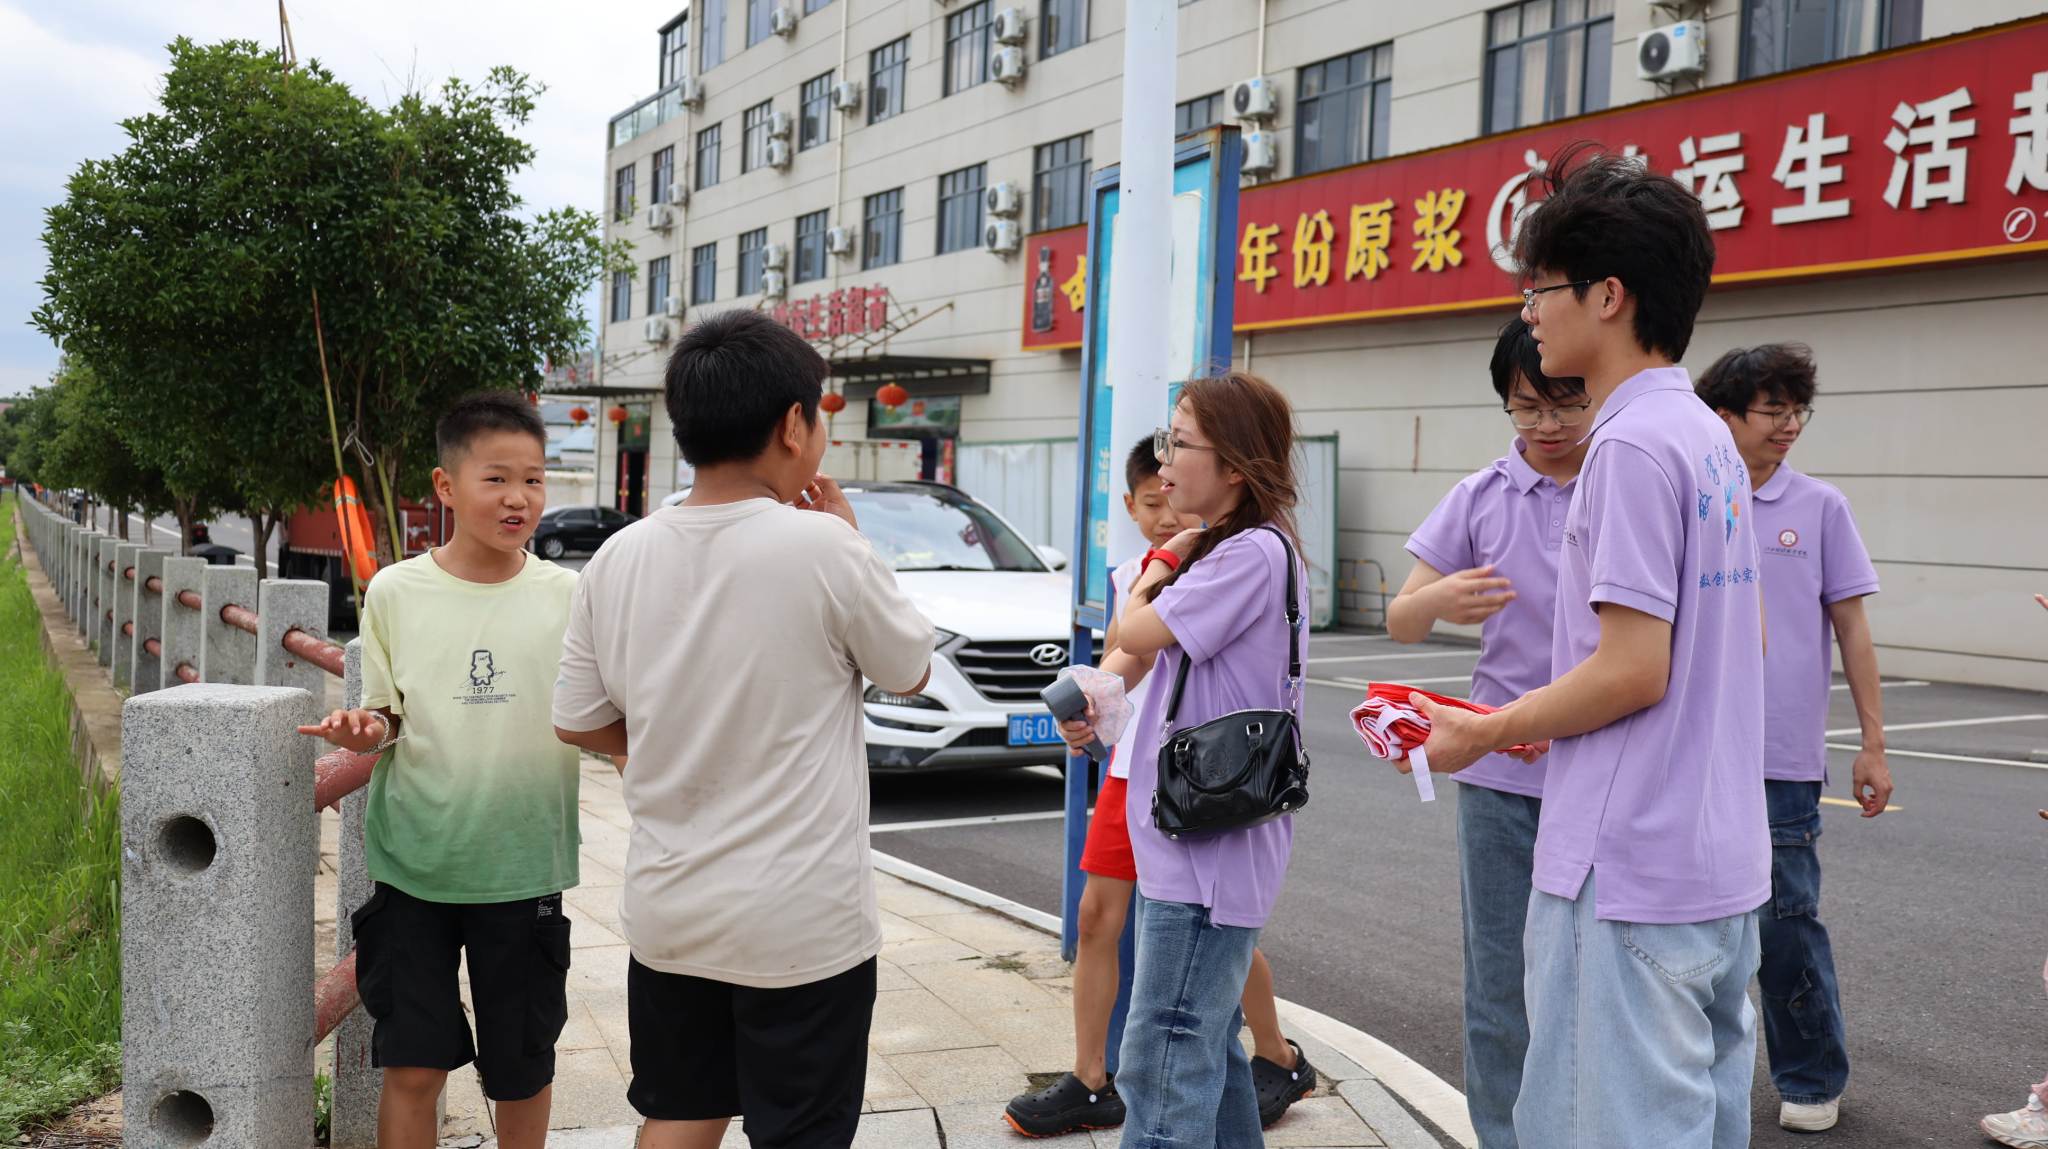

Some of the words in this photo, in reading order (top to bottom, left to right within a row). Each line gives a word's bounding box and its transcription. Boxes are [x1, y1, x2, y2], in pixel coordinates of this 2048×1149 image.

[1238, 187, 1467, 294] 年份原浆
[472, 686, 495, 694] 1977
